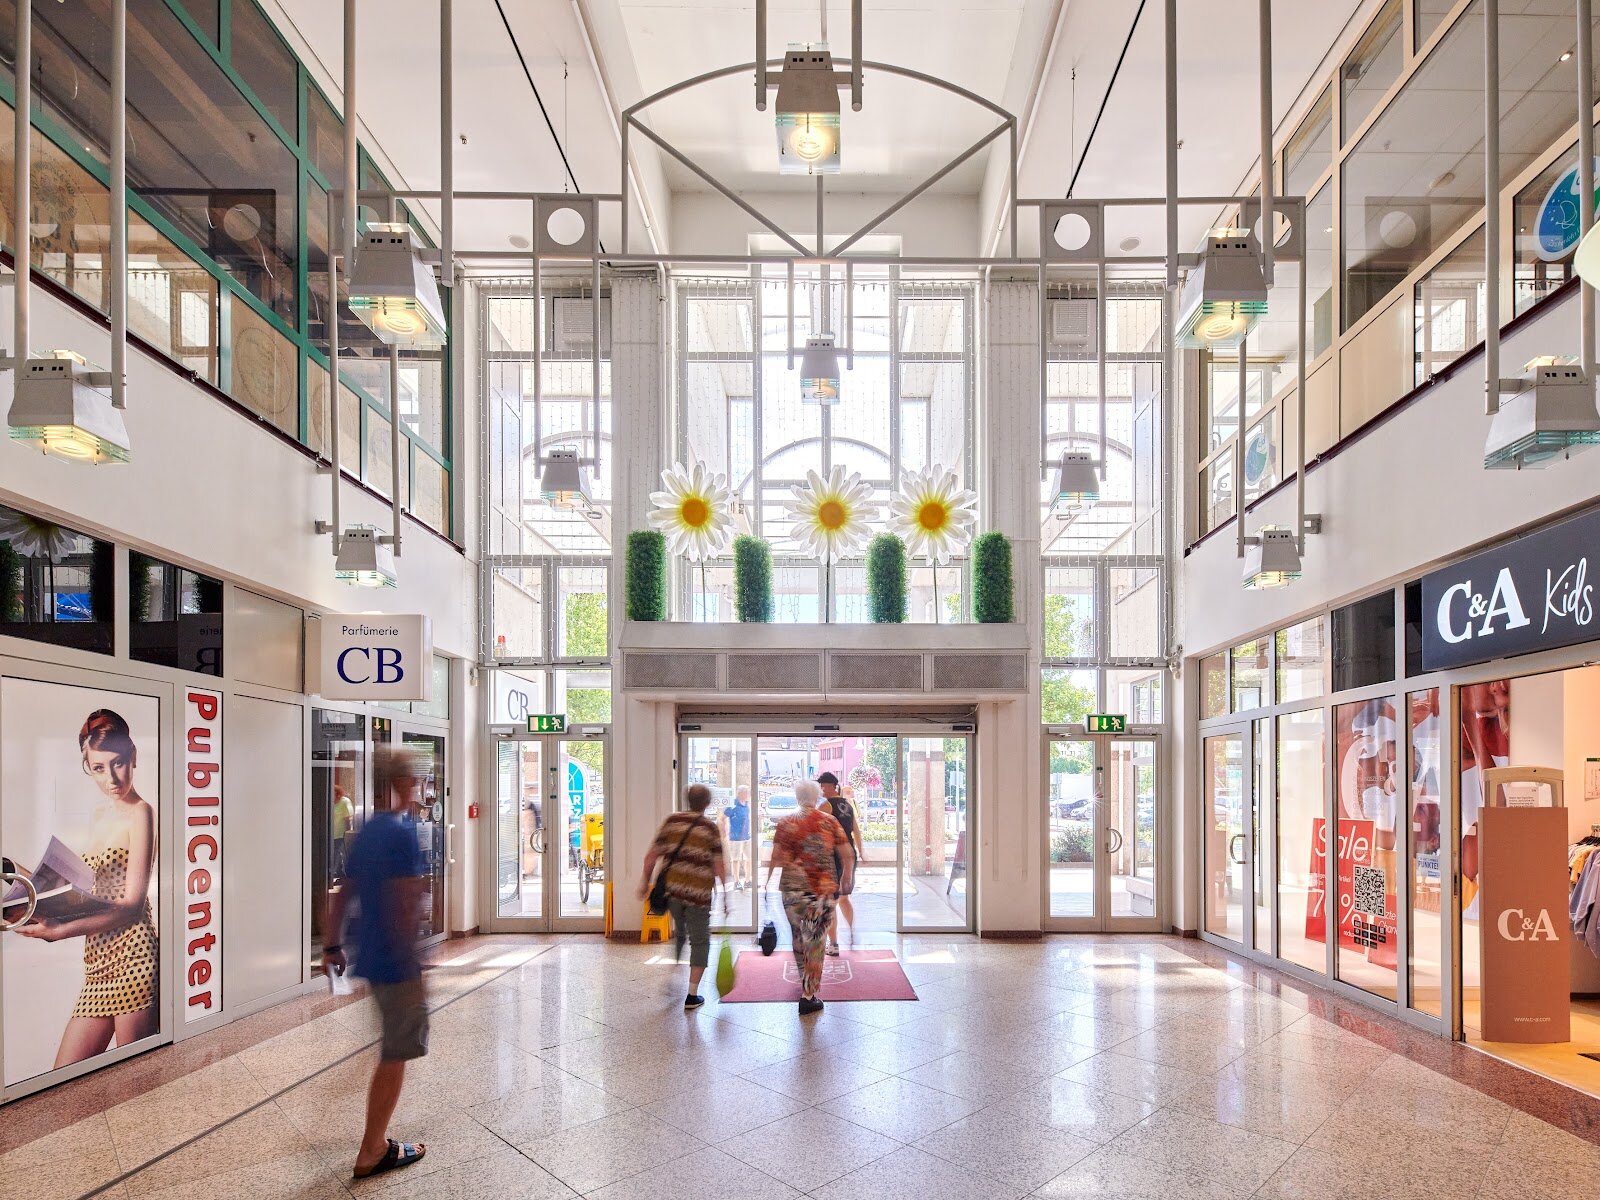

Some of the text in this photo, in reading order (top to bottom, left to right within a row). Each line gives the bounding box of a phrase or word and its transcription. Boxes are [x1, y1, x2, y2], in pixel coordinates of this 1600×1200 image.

[1437, 557, 1593, 644] C&A Kids
[342, 625, 399, 636] Parfümerie
[337, 647, 404, 684] CB
[507, 689, 529, 722] CB
[1497, 908, 1560, 942] C&A
[1513, 1015, 1552, 1023] www.c-a.com
